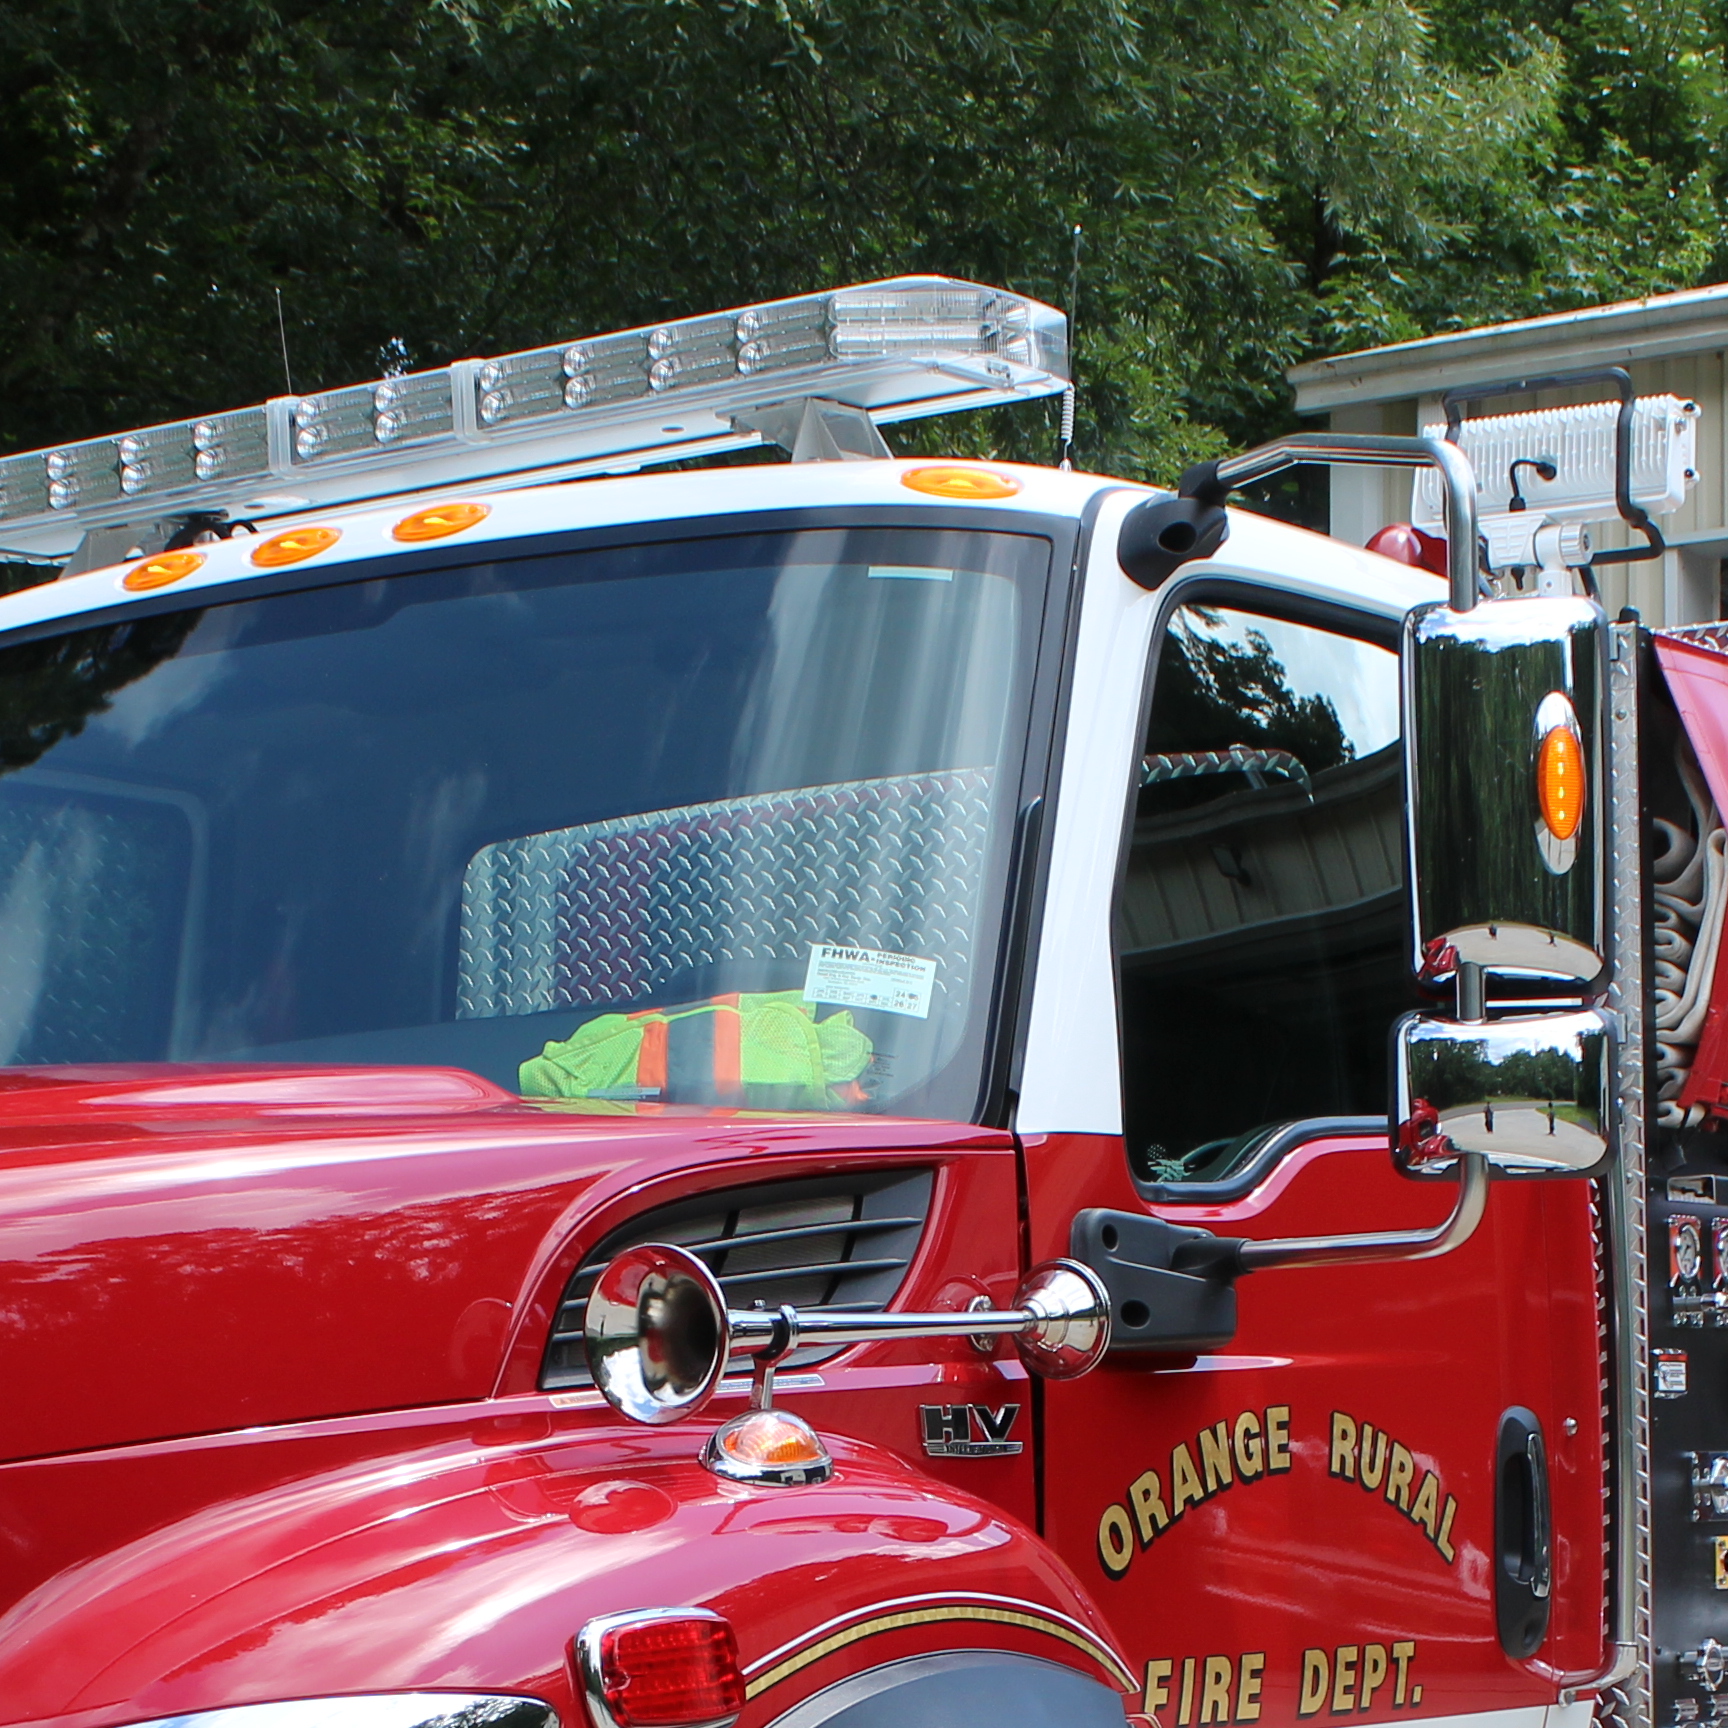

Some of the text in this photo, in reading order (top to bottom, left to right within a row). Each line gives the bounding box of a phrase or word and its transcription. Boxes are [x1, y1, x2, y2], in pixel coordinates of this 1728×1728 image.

[919, 1404, 1021, 1443] HV
[1097, 1405, 1459, 1579] ORANGE RURAL
[1144, 1640, 1424, 1728] FIRE DEPT.
